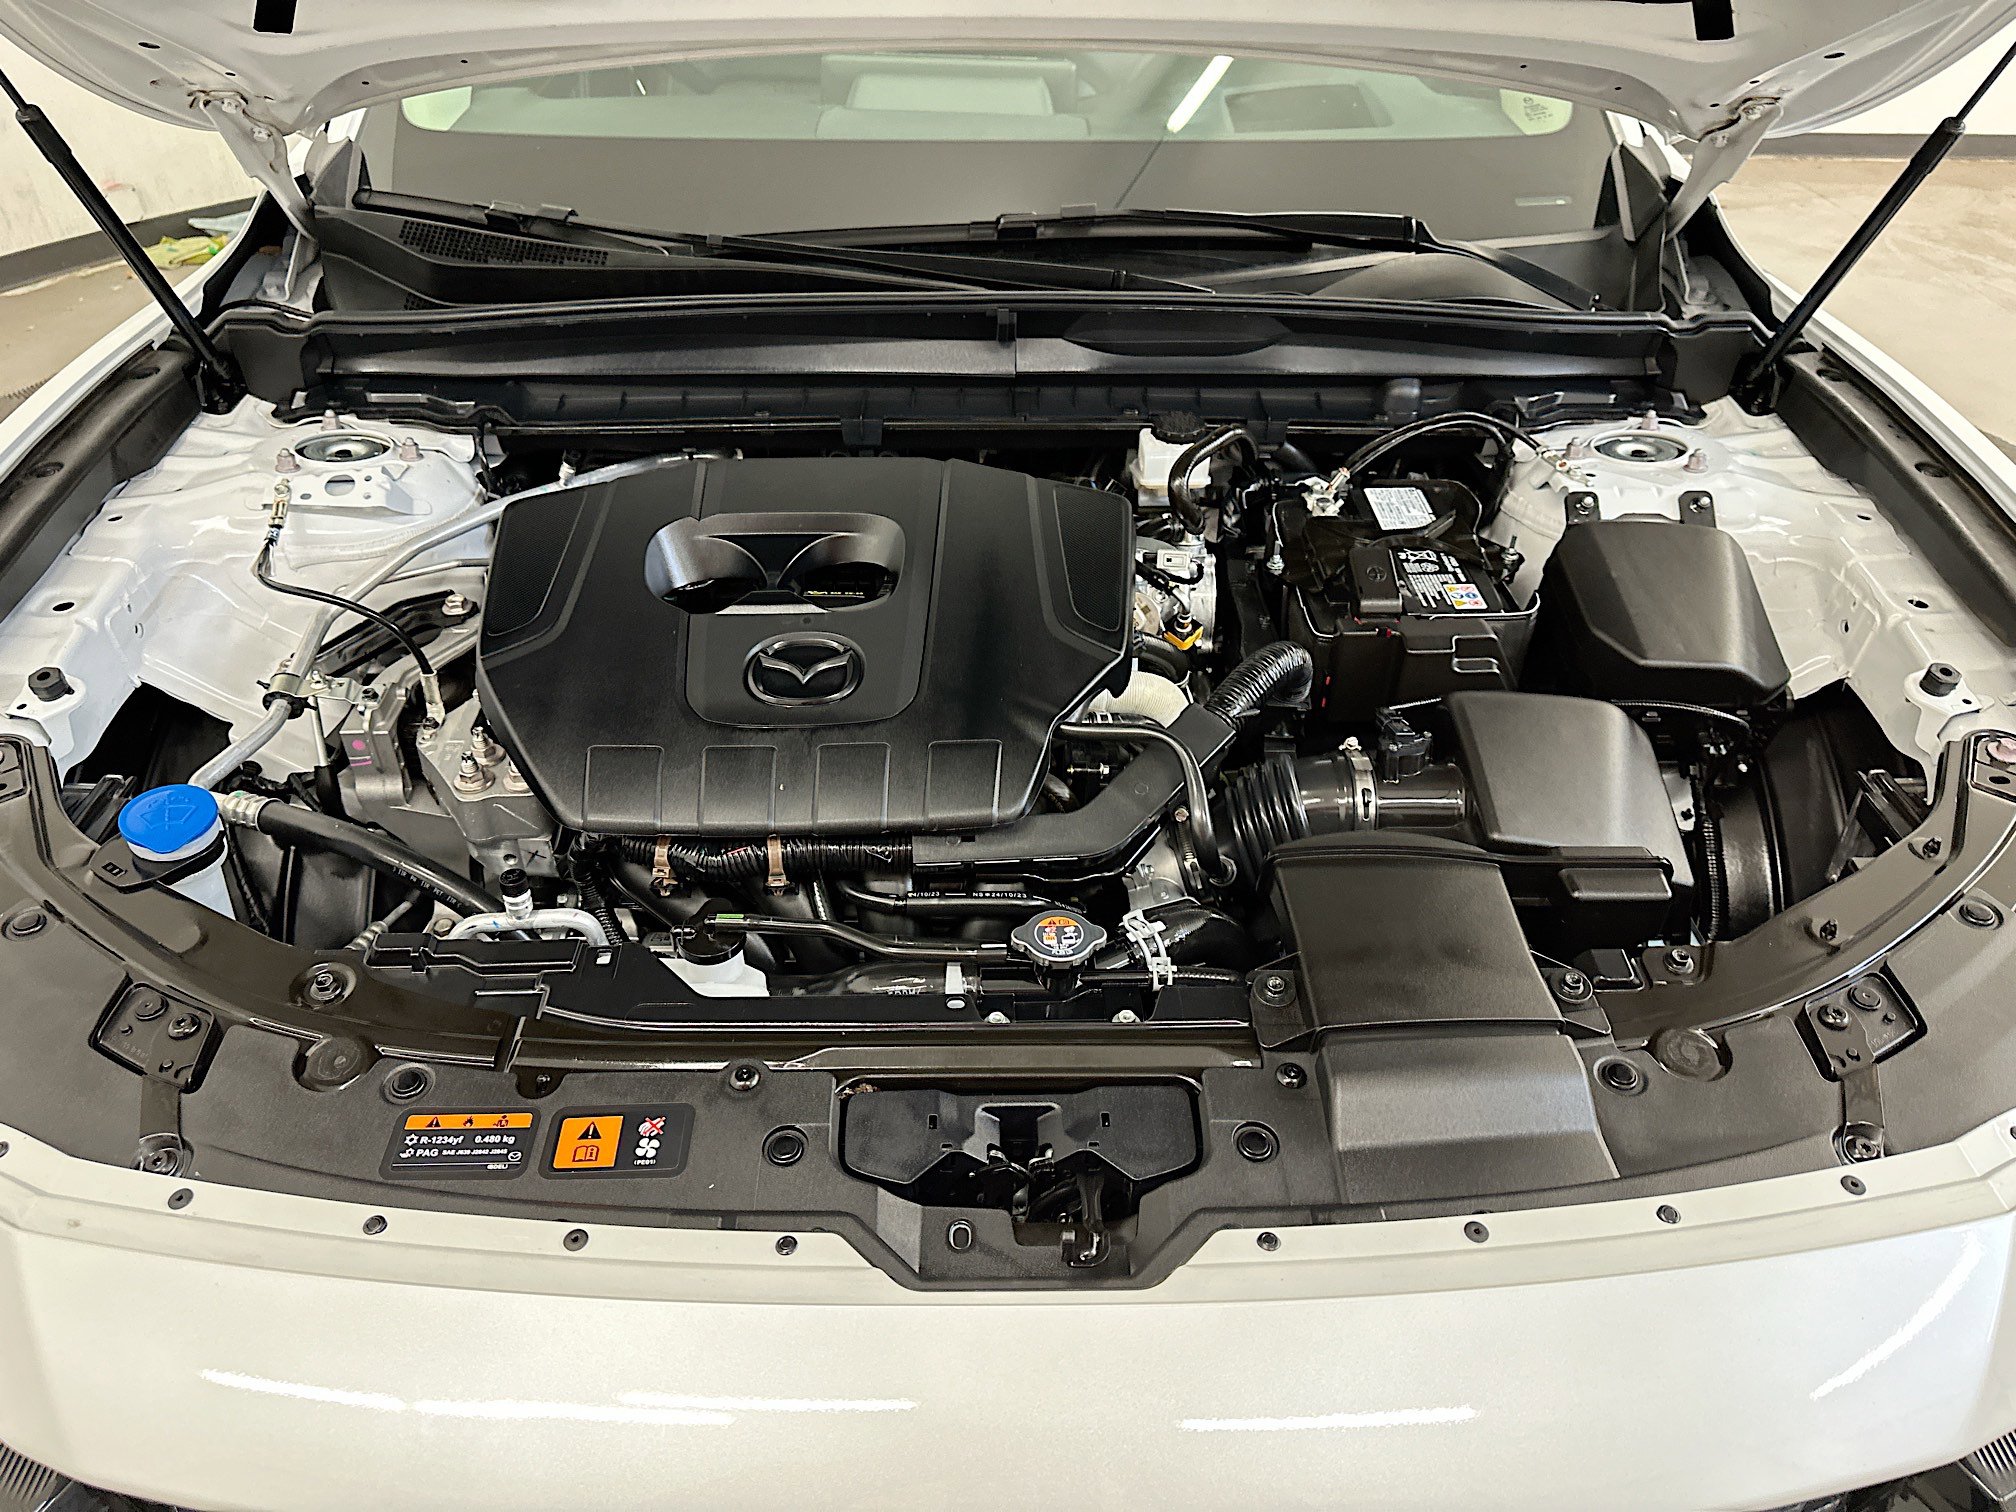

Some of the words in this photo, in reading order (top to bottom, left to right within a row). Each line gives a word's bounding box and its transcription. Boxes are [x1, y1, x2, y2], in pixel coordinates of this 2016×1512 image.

[420, 1135, 465, 1145] R-1234yf
[474, 1135, 501, 1144] 0.480
[502, 1135, 516, 1145] kg
[415, 1148, 439, 1157] PAG
